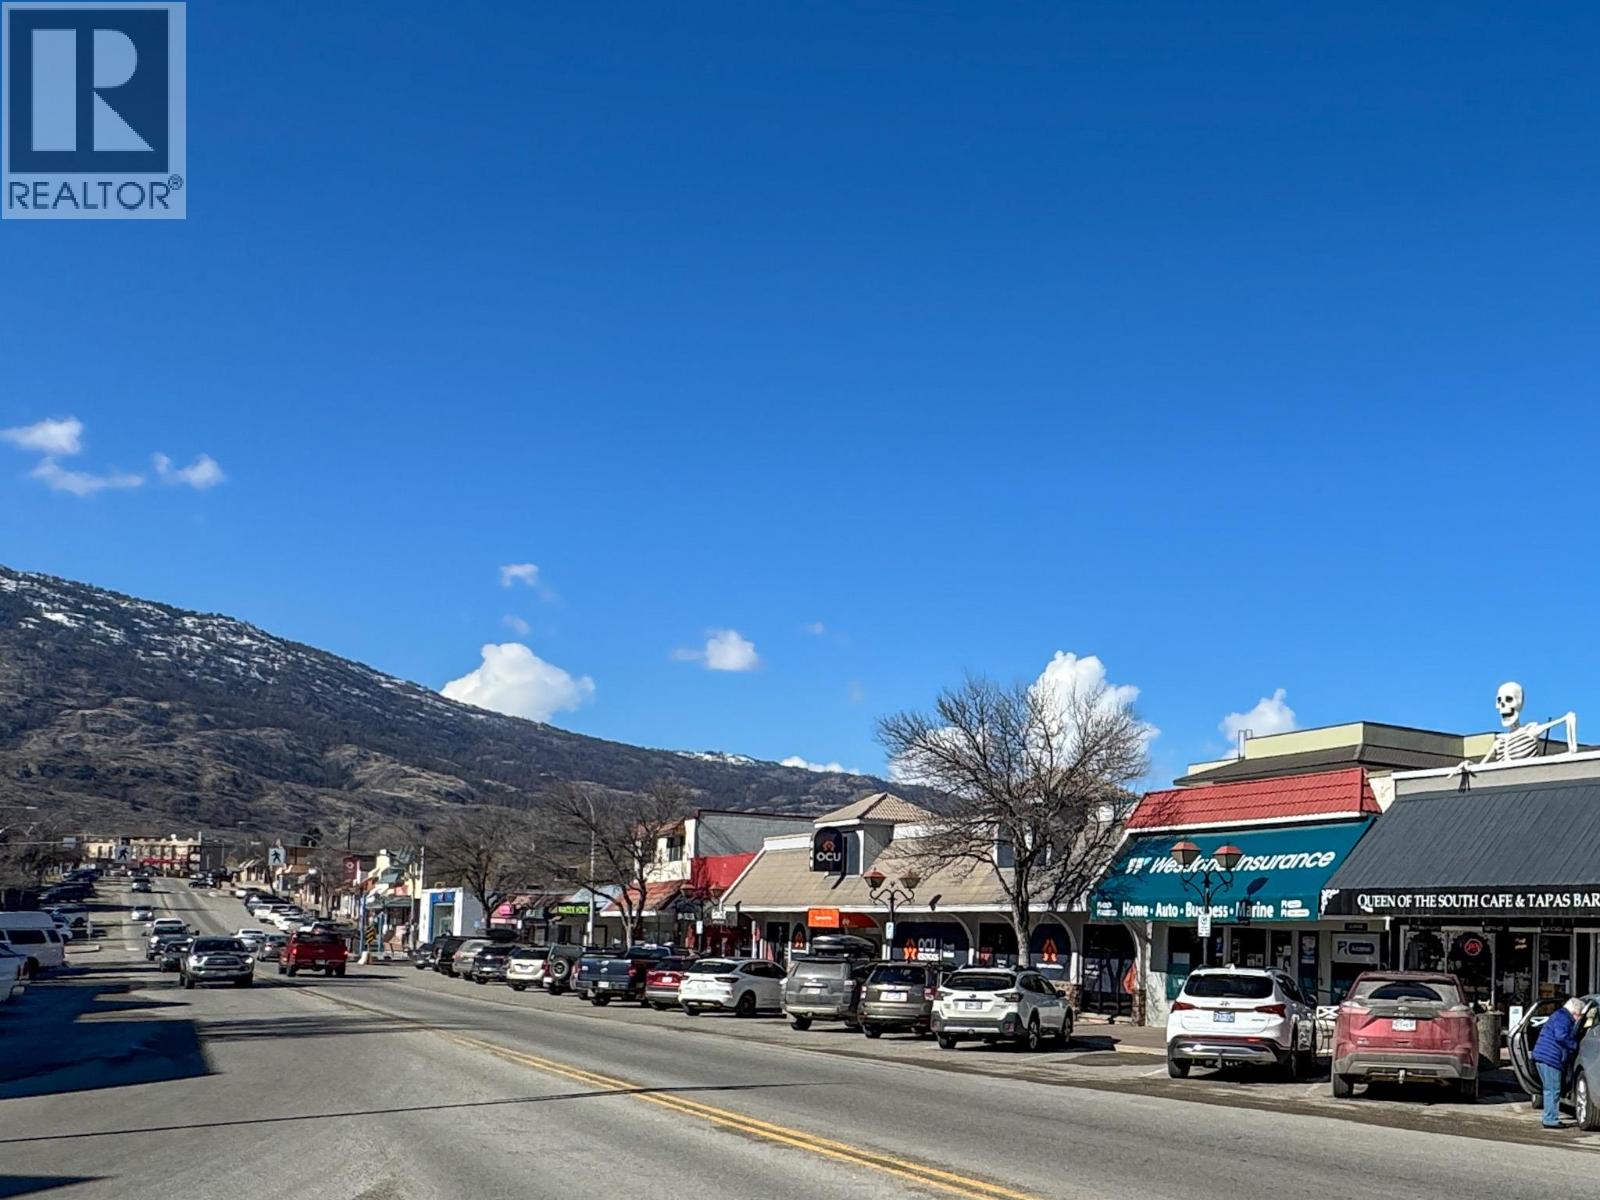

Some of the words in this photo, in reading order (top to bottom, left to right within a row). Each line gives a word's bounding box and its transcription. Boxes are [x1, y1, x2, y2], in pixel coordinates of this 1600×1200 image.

[816, 851, 841, 862] OCU
[1149, 855, 1229, 873] Weslan
[1231, 851, 1336, 871] Insurance
[1122, 901, 1149, 917] Home
[1155, 902, 1178, 917] Auto
[1235, 901, 1274, 918] Marine
[1357, 894, 1396, 913] QUEEN
[1397, 894, 1413, 908] OF
[1414, 894, 1437, 908] THE
[1438, 894, 1479, 908] SOUTH
[1480, 894, 1513, 908] CAFE
[1515, 894, 1525, 908] &
[1527, 893, 1571, 908] TAPAS
[1573, 893, 1600, 908] BAR
